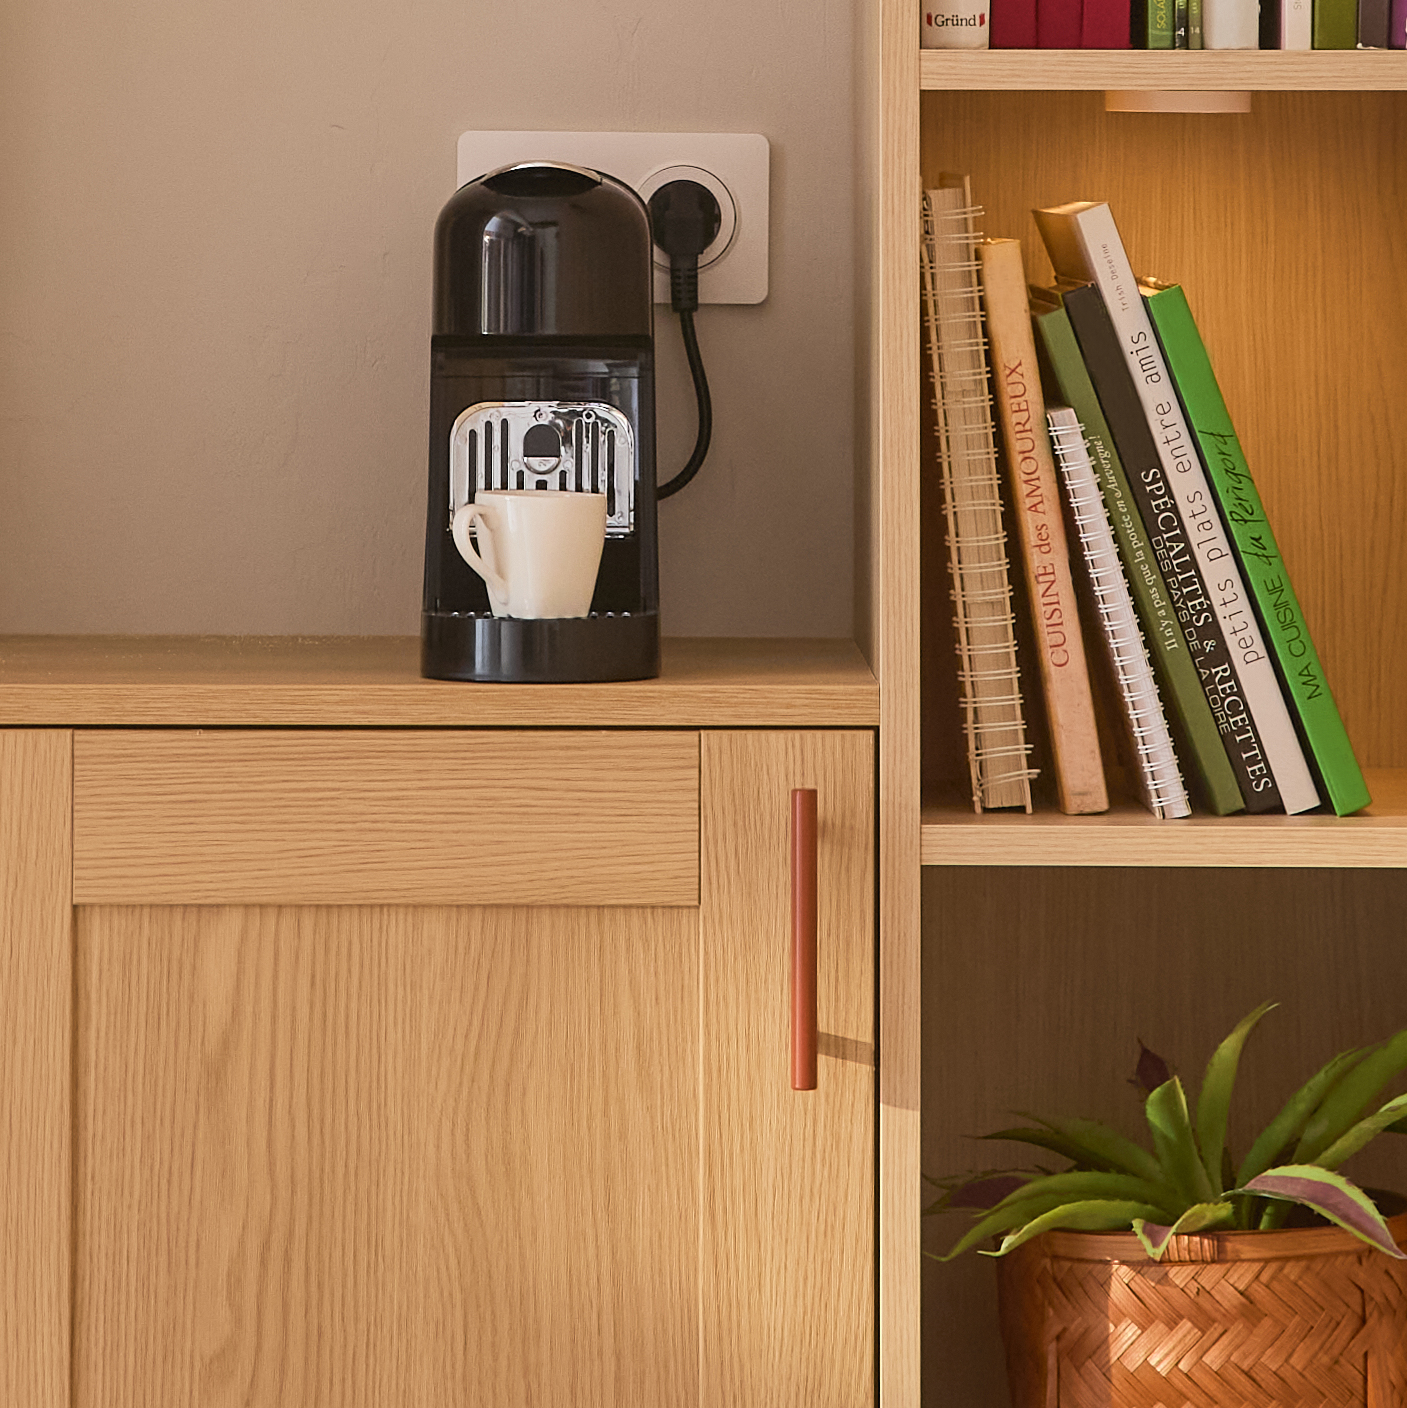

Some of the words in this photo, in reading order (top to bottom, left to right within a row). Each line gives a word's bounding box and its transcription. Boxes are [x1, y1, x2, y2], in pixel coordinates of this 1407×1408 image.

[934, 14, 977, 27] Gründ
[1130, 331, 1161, 385] amis
[1003, 359, 1046, 515] AMOUREUX
[1155, 401, 1192, 473] entre
[1116, 500, 1128, 513] en
[1121, 514, 1144, 549] potée
[1186, 490, 1230, 562] plats
[1033, 523, 1052, 555] des
[1134, 549, 1145, 563] la
[1140, 563, 1157, 586] que
[1149, 587, 1166, 608] pas
[1037, 562, 1070, 668] CUISINE
[1140, 468, 1213, 627] SPÉCIALITÉS
[1203, 639, 1217, 653] &
[1211, 662, 1273, 792] RECETTES
[1152, 536, 1172, 572] DES
[1167, 577, 1190, 623] PAYS
[1184, 627, 1201, 651] DE
[1195, 656, 1210, 681] LA
[1205, 685, 1231, 735] LOIRE
[1217, 578, 1266, 665] petits
[1263, 574, 1307, 658] CUISINE
[1298, 661, 1323, 700] MA
